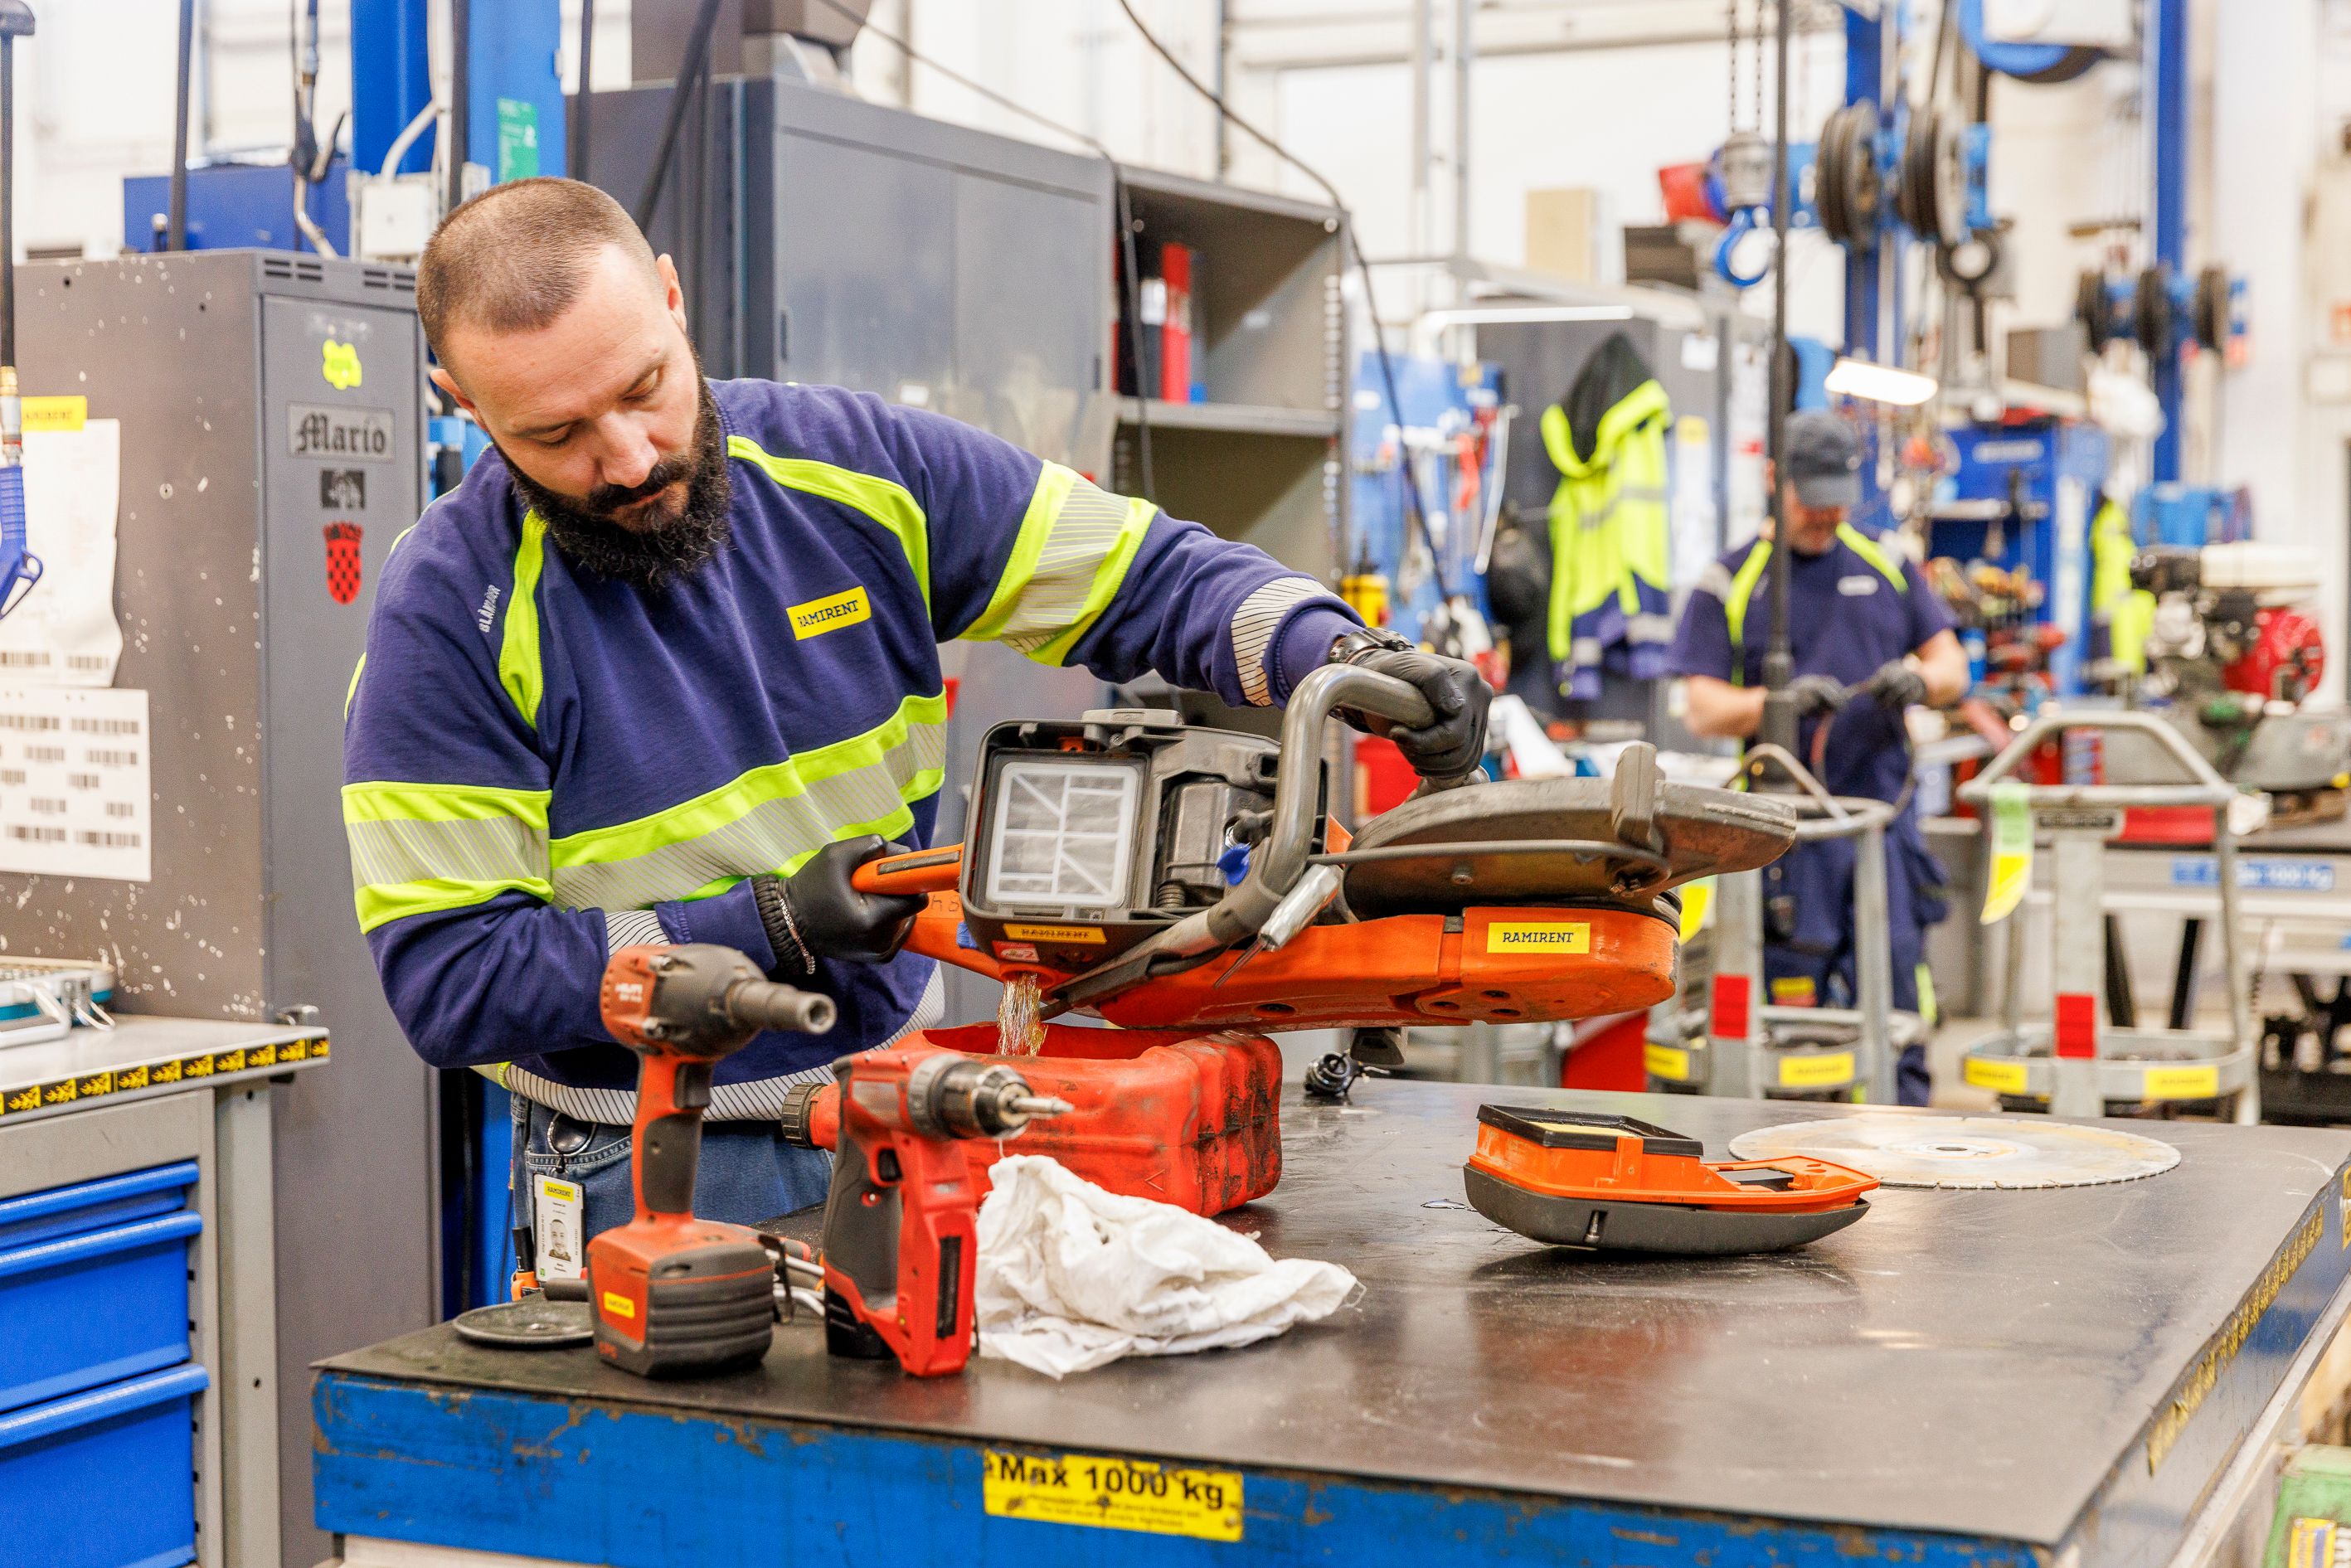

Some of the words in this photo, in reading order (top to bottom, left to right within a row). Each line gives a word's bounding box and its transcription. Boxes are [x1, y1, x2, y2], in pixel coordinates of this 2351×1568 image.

[295, 413, 386, 454] Mario
[797, 600, 859, 629] AMIRENT
[1503, 932, 1574, 943] RAMIRENT
[999, 1455, 1068, 1488] Max
[1085, 1465, 1168, 1497] 1000
[1183, 1476, 1224, 1511] kg
